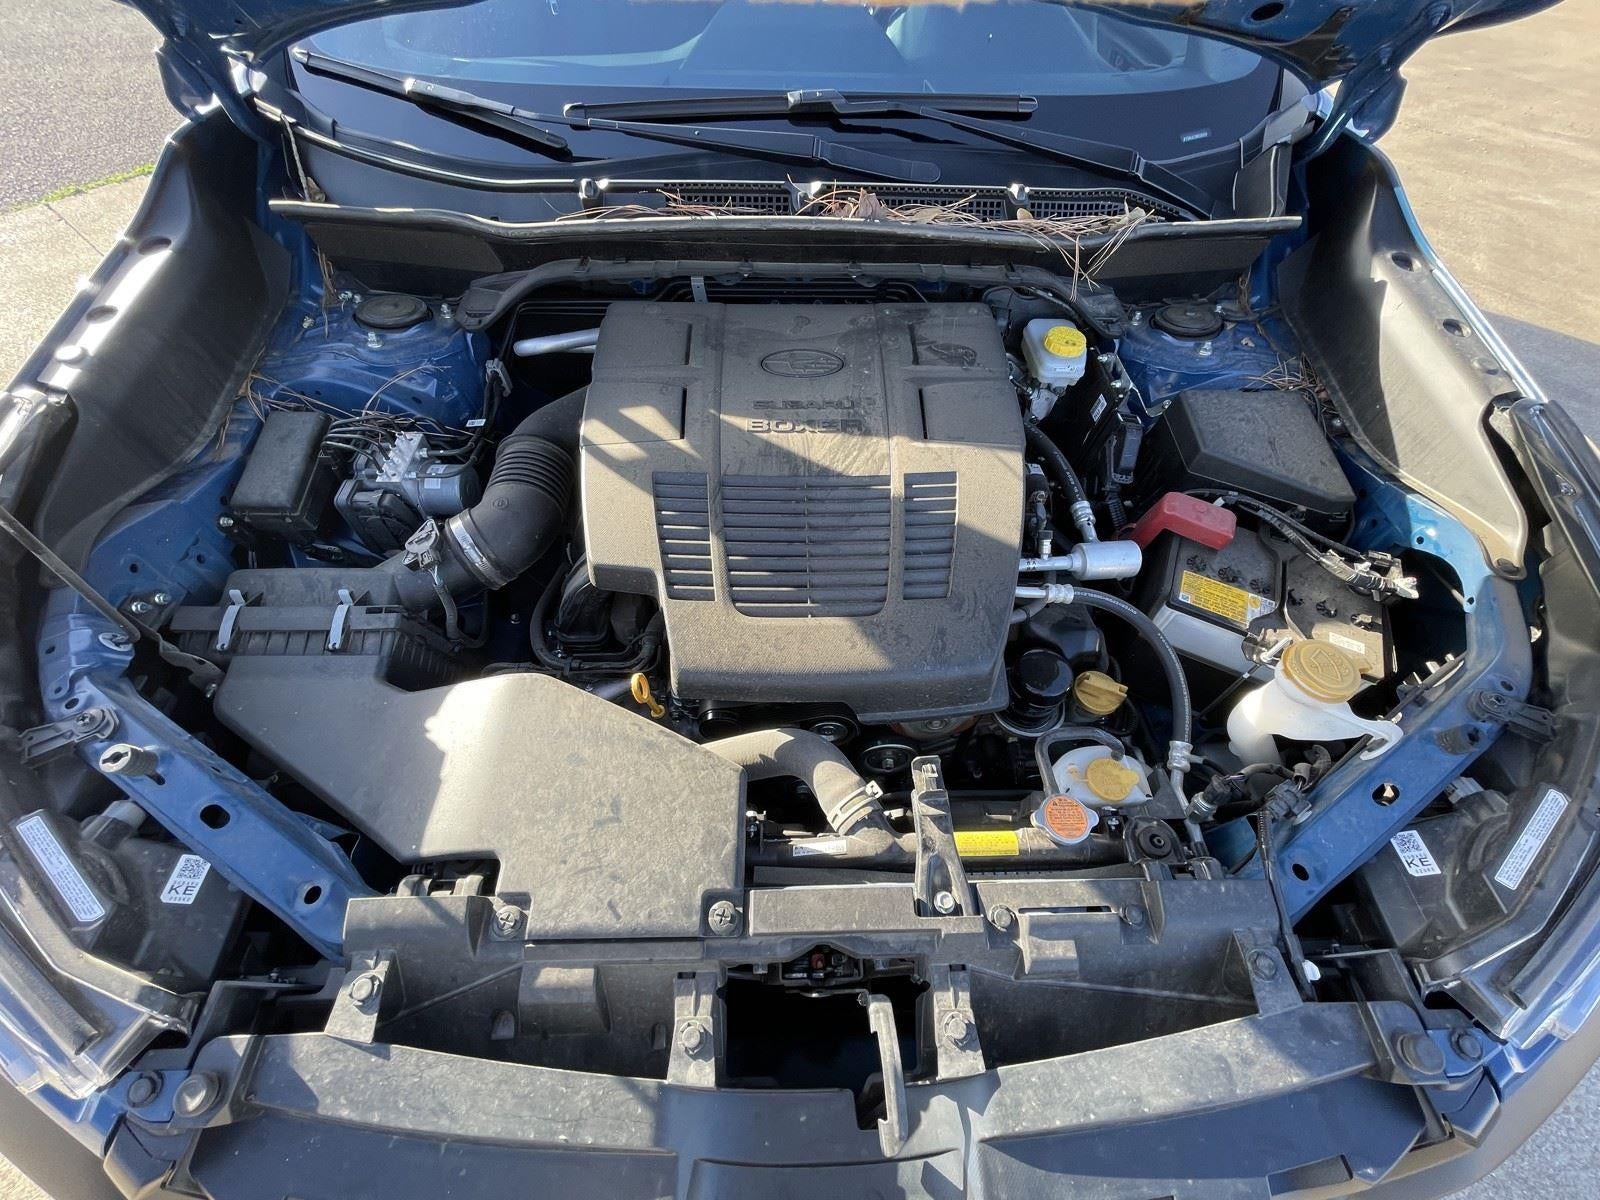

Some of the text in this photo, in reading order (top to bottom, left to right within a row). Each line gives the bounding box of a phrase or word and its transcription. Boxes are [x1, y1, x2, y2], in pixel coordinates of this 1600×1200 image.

[747, 419, 863, 434] BOXER
[1405, 857, 1433, 868] KE
[168, 884, 196, 896] KE
